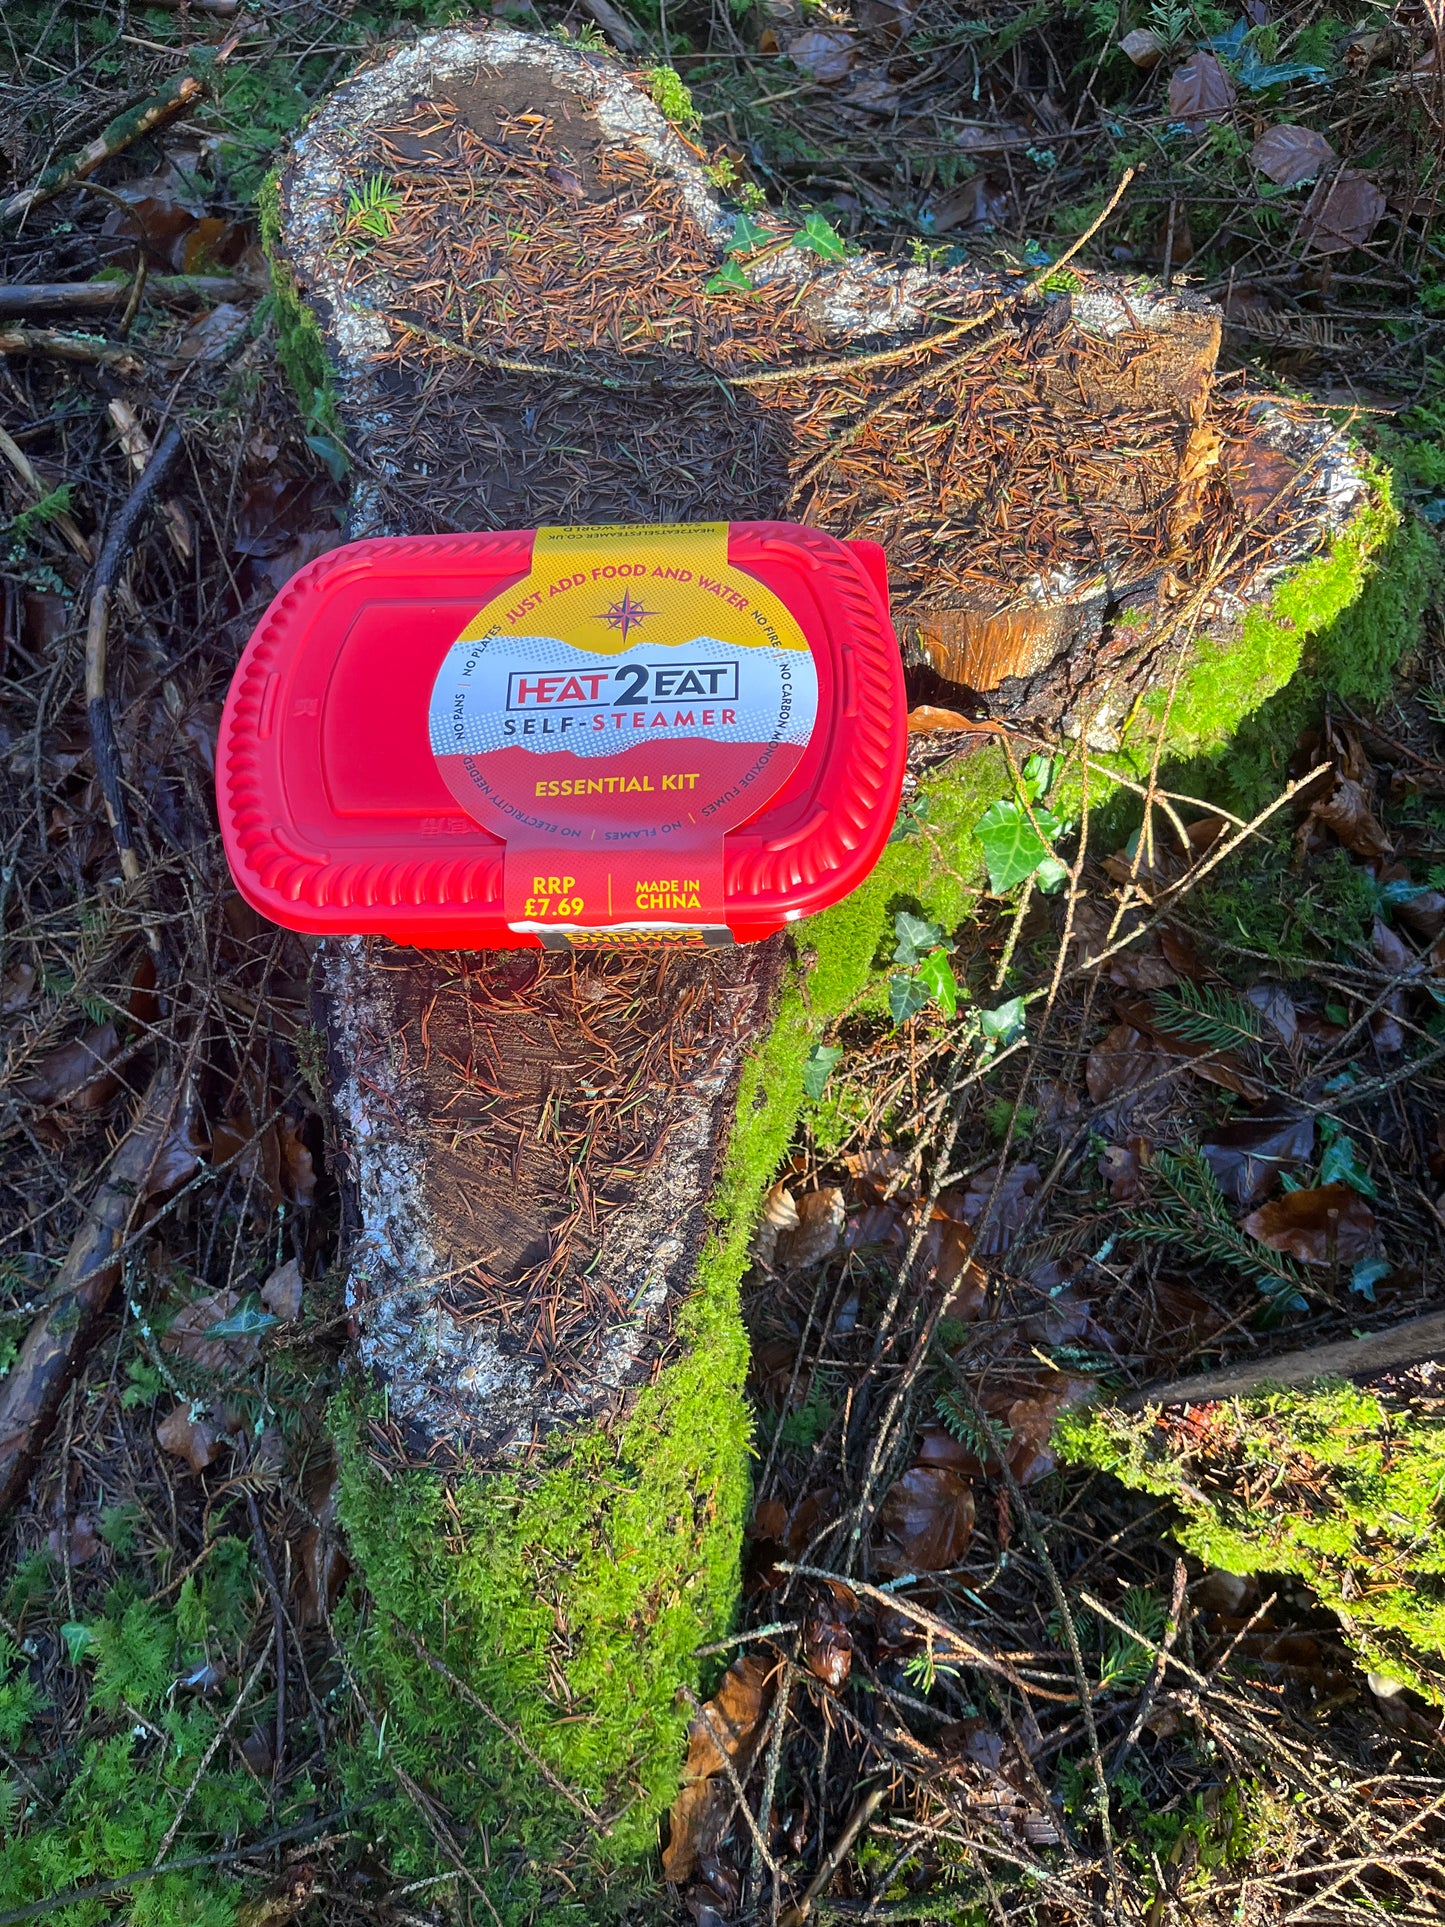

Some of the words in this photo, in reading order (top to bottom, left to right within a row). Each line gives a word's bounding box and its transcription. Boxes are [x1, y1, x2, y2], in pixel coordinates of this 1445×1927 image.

[505, 591, 543, 625] JUST
[548, 573, 586, 597] ADD
[592, 564, 647, 581] FOOD
[651, 566, 693, 583] AND
[698, 575, 750, 612] WATER
[750, 610, 767, 626] NO
[763, 626, 782, 648] FIRE
[462, 660, 476, 677] NO
[471, 624, 502, 658] PLATES
[779, 663, 791, 680] NO
[453, 693, 466, 720] PANS
[777, 683, 793, 729] CARBON
[453, 724, 466, 740] NO
[503, 709, 737, 736] SELF-STEAMER
[739, 731, 784, 788] MONOXIDE
[463, 756, 493, 795] NEEDED
[535, 776, 655, 797] ESSENTIAL
[661, 773, 700, 791] KIT
[489, 794, 559, 833] ELECTRICITY
[701, 786, 741, 817] FUMES
[561, 827, 582, 838] NO
[604, 828, 657, 841] FLAMES
[661, 820, 682, 833] NO
[533, 876, 576, 895] RRP
[635, 881, 679, 893] MADE
[683, 880, 700, 892] IN
[524, 897, 585, 917] £7.69
[635, 893, 702, 910] CHINA
[567, 934, 704, 944] CAMPING
